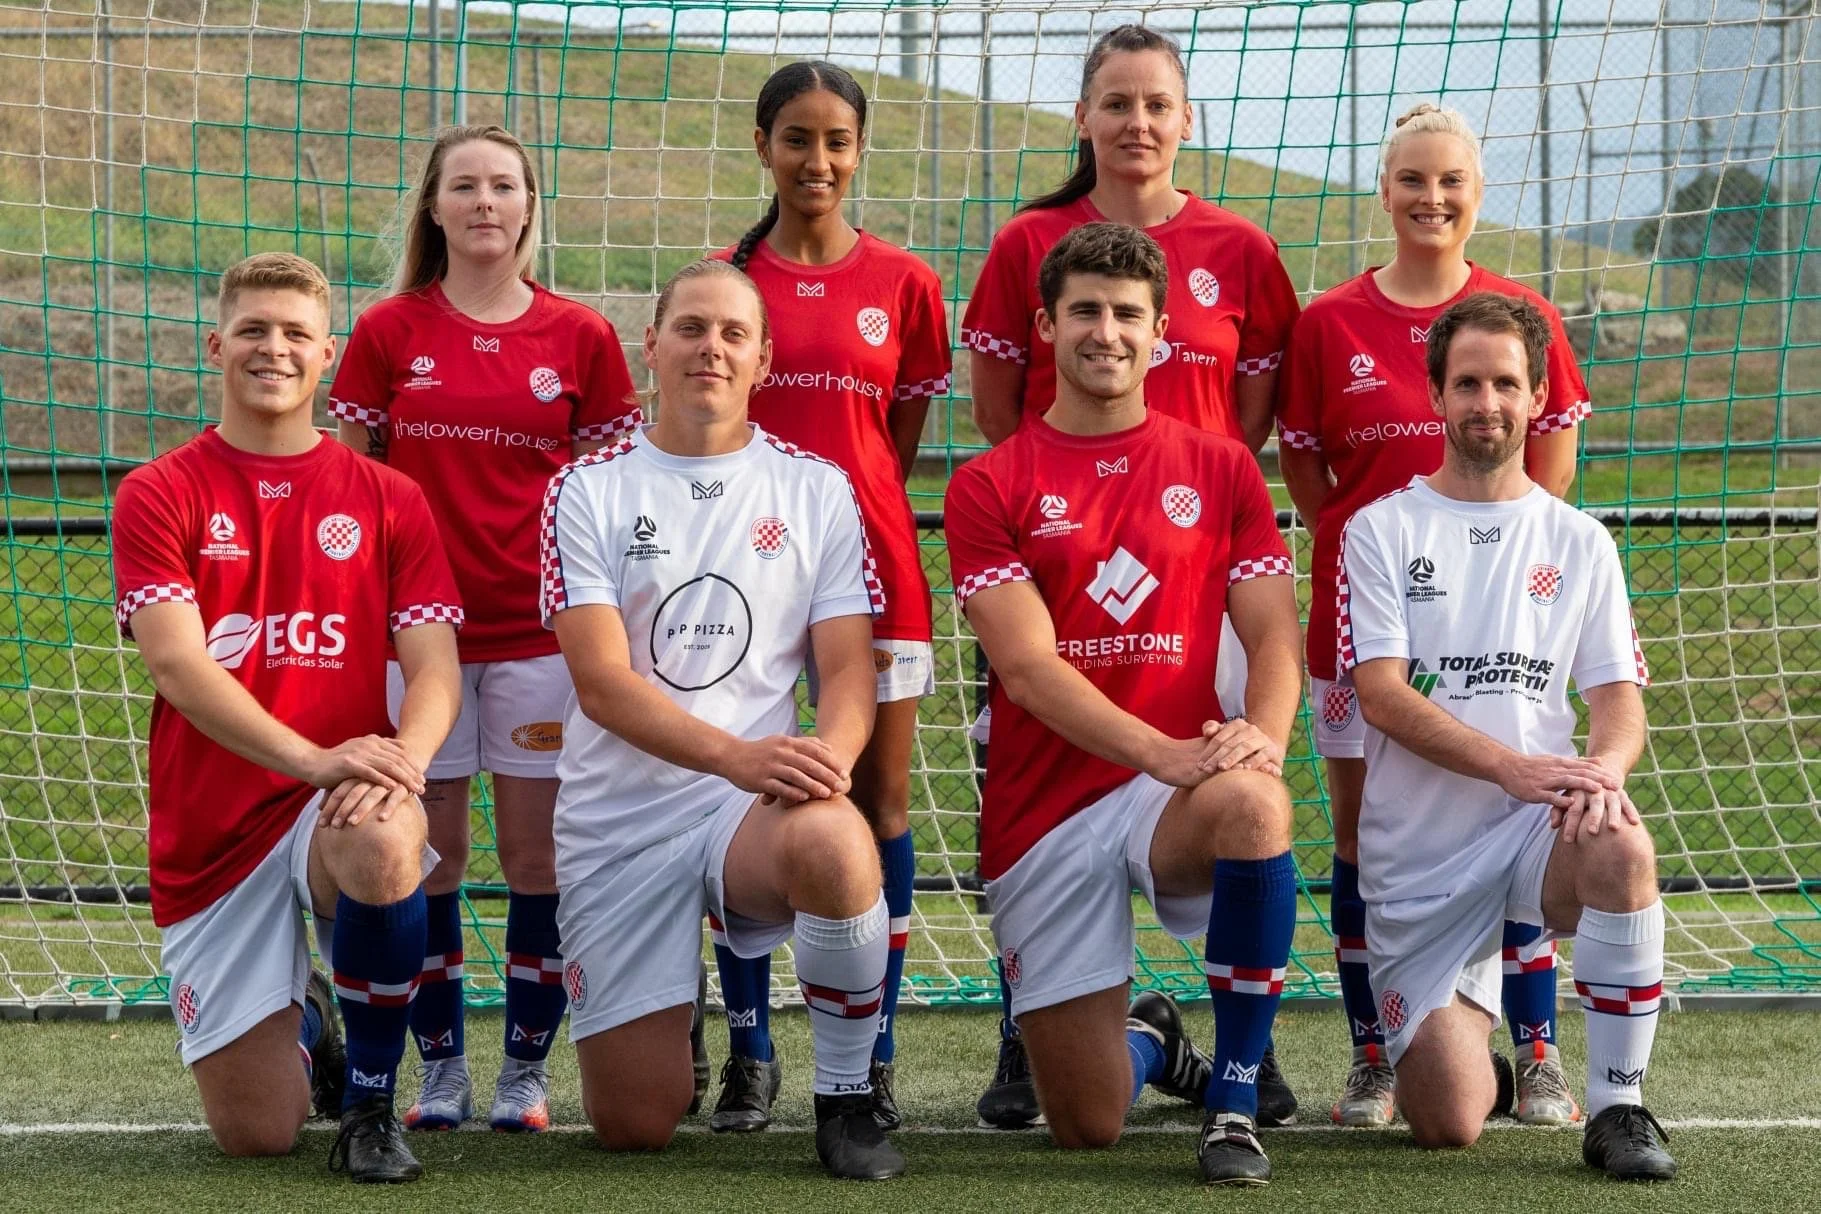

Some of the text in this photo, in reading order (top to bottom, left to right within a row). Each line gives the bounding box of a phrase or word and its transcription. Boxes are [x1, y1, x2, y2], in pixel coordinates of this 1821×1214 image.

[1171, 342, 1217, 367] Tavern
[762, 370, 882, 400] owerhouse
[395, 418, 559, 450] thelowerhouse
[1345, 421, 1446, 449] thelower
[1040, 520, 1071, 529] NATIONAL
[266, 611, 346, 656] EGS
[694, 624, 735, 636] PIZZA
[1056, 633, 1183, 657] FREESTONE
[266, 655, 345, 669] Electric Gas Solar
[1071, 652, 1183, 670] ILDING SURVEYING
[1439, 652, 1556, 676] TOTAL SURFAE
[1475, 688, 1504, 696] Blasting
